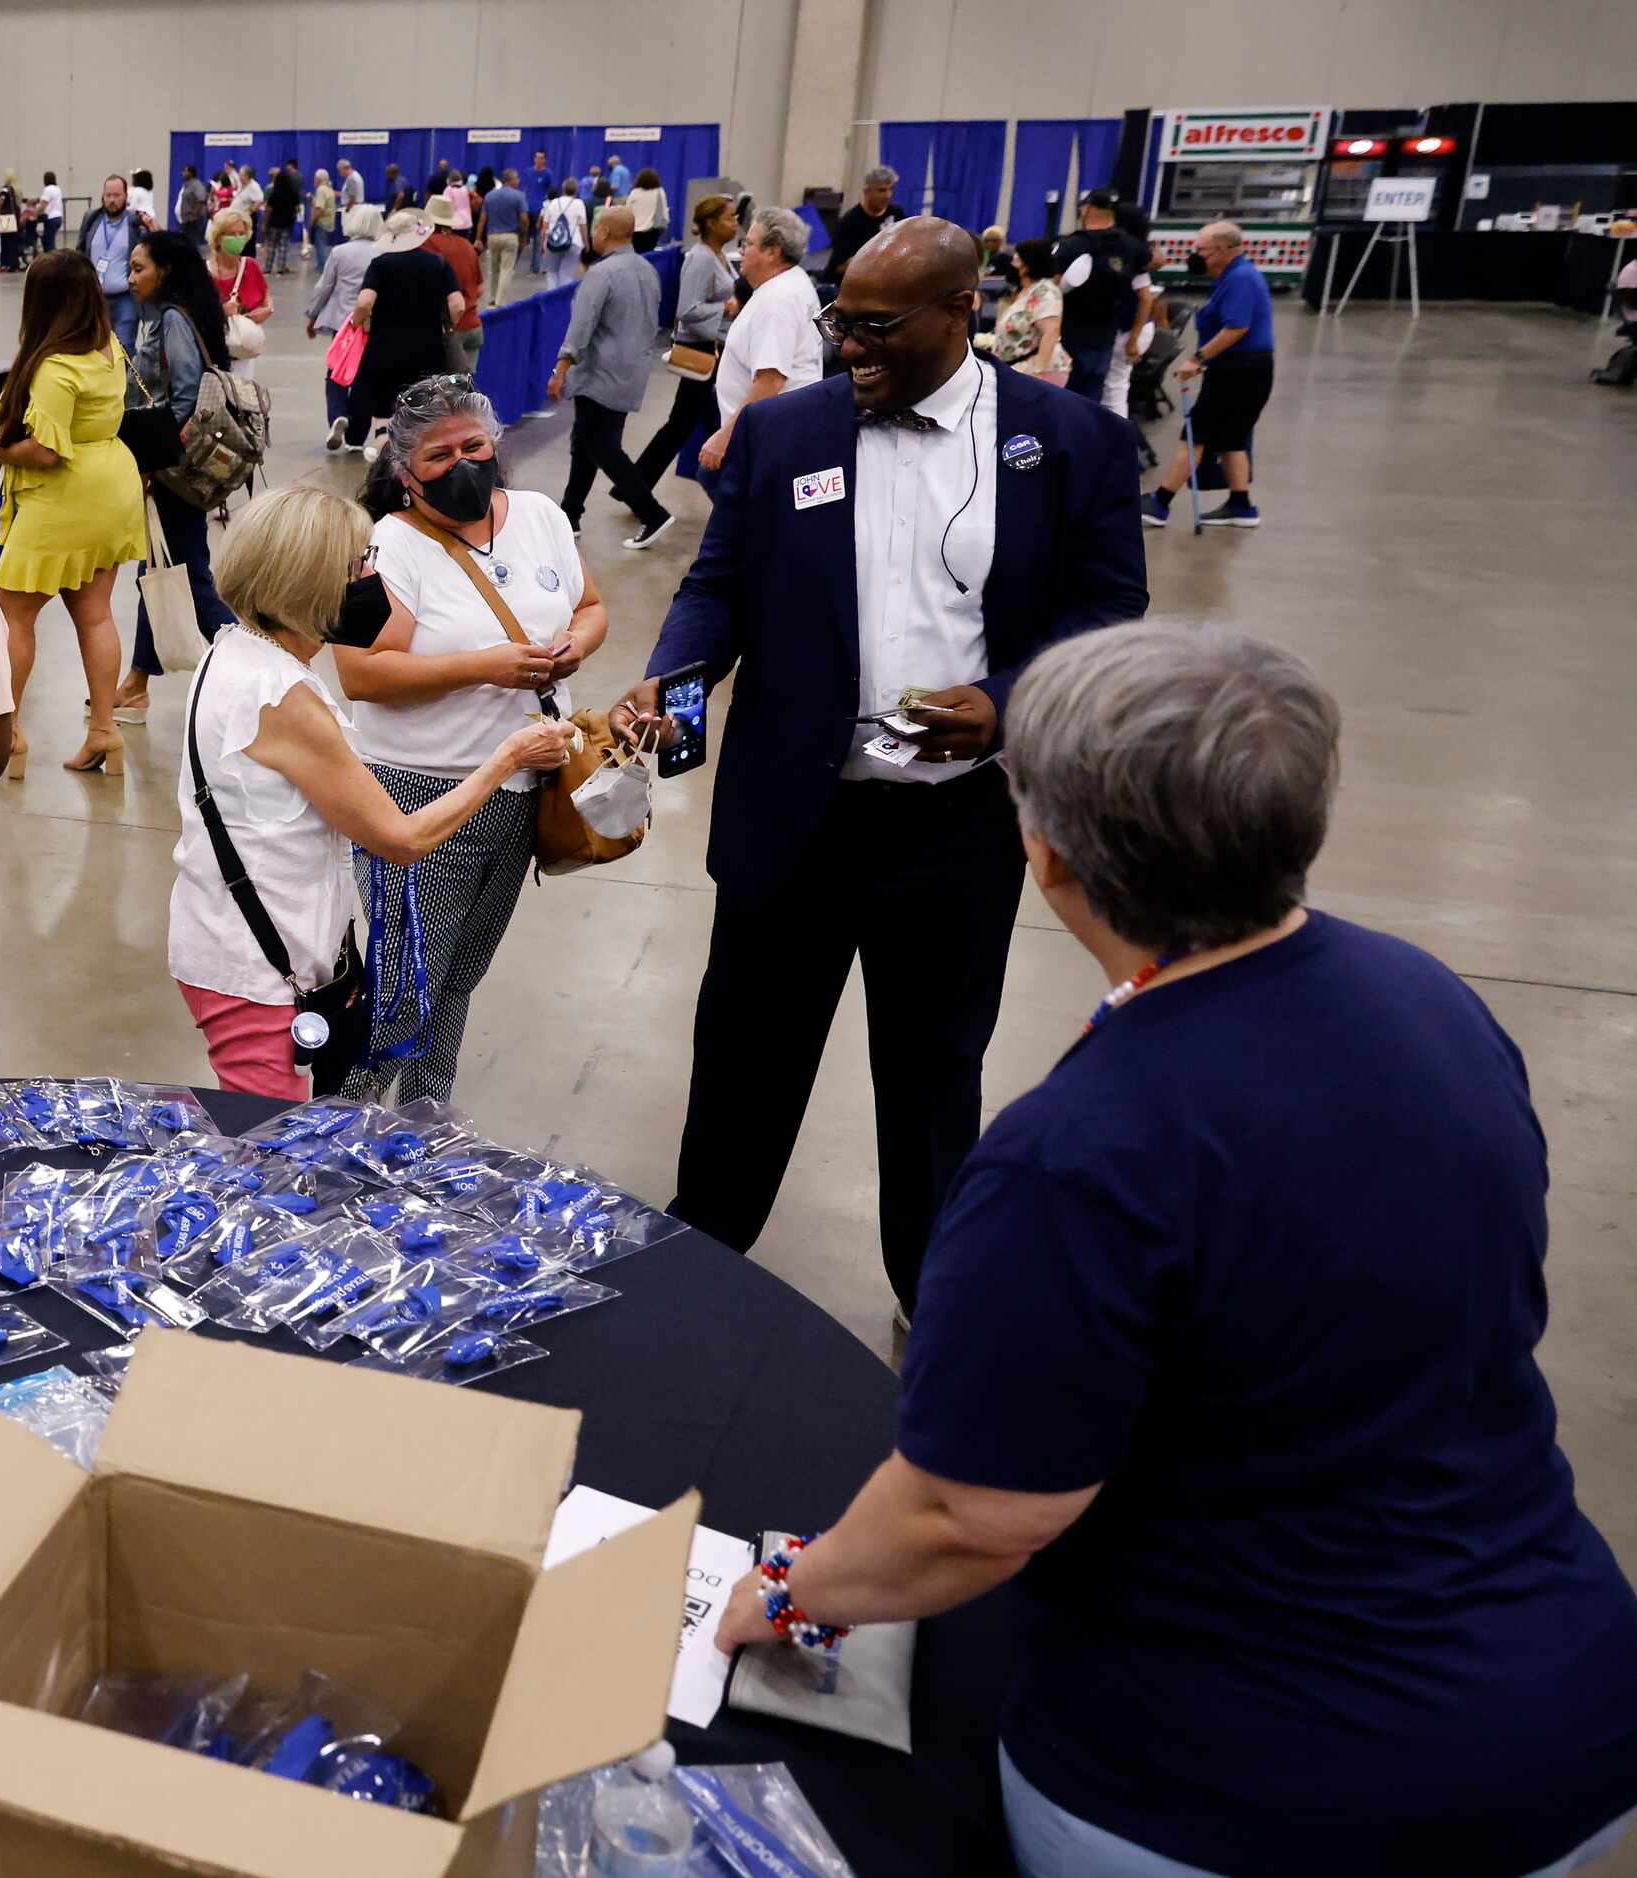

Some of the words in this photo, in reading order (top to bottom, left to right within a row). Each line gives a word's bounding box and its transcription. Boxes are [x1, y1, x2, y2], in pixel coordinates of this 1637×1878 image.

[1183, 124, 1306, 144] alfresco
[1372, 190, 1426, 207] ENTER
[796, 474, 820, 486] JOHN
[408, 885, 420, 935] DEMOCRATIC
[414, 936, 423, 969] WOMEN
